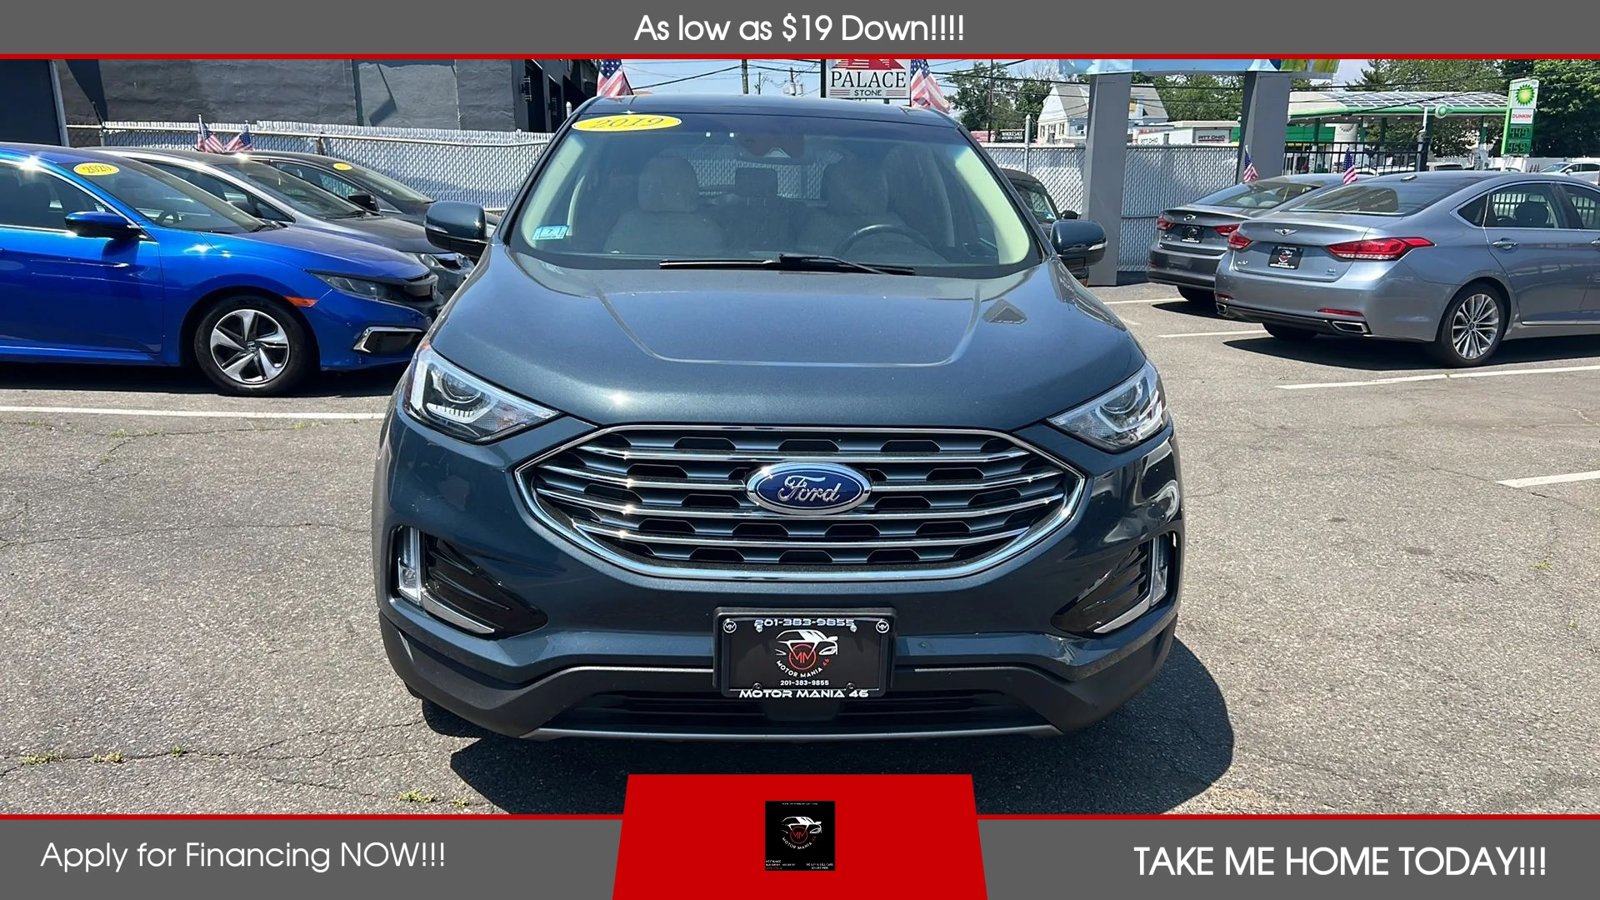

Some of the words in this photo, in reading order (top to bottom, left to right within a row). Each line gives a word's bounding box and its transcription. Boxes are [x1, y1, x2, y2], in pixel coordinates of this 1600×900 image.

[830, 70, 907, 88] PALACE
[591, 117, 665, 129] 2019
[777, 475, 842, 502] Ford
[754, 618, 855, 627] 201-383-9855
[776, 660, 798, 678] MOTOR
[800, 667, 823, 678] MANIA
[738, 690, 793, 699] MOTOR
[796, 690, 845, 699] MANIA
[848, 690, 869, 699] 46
